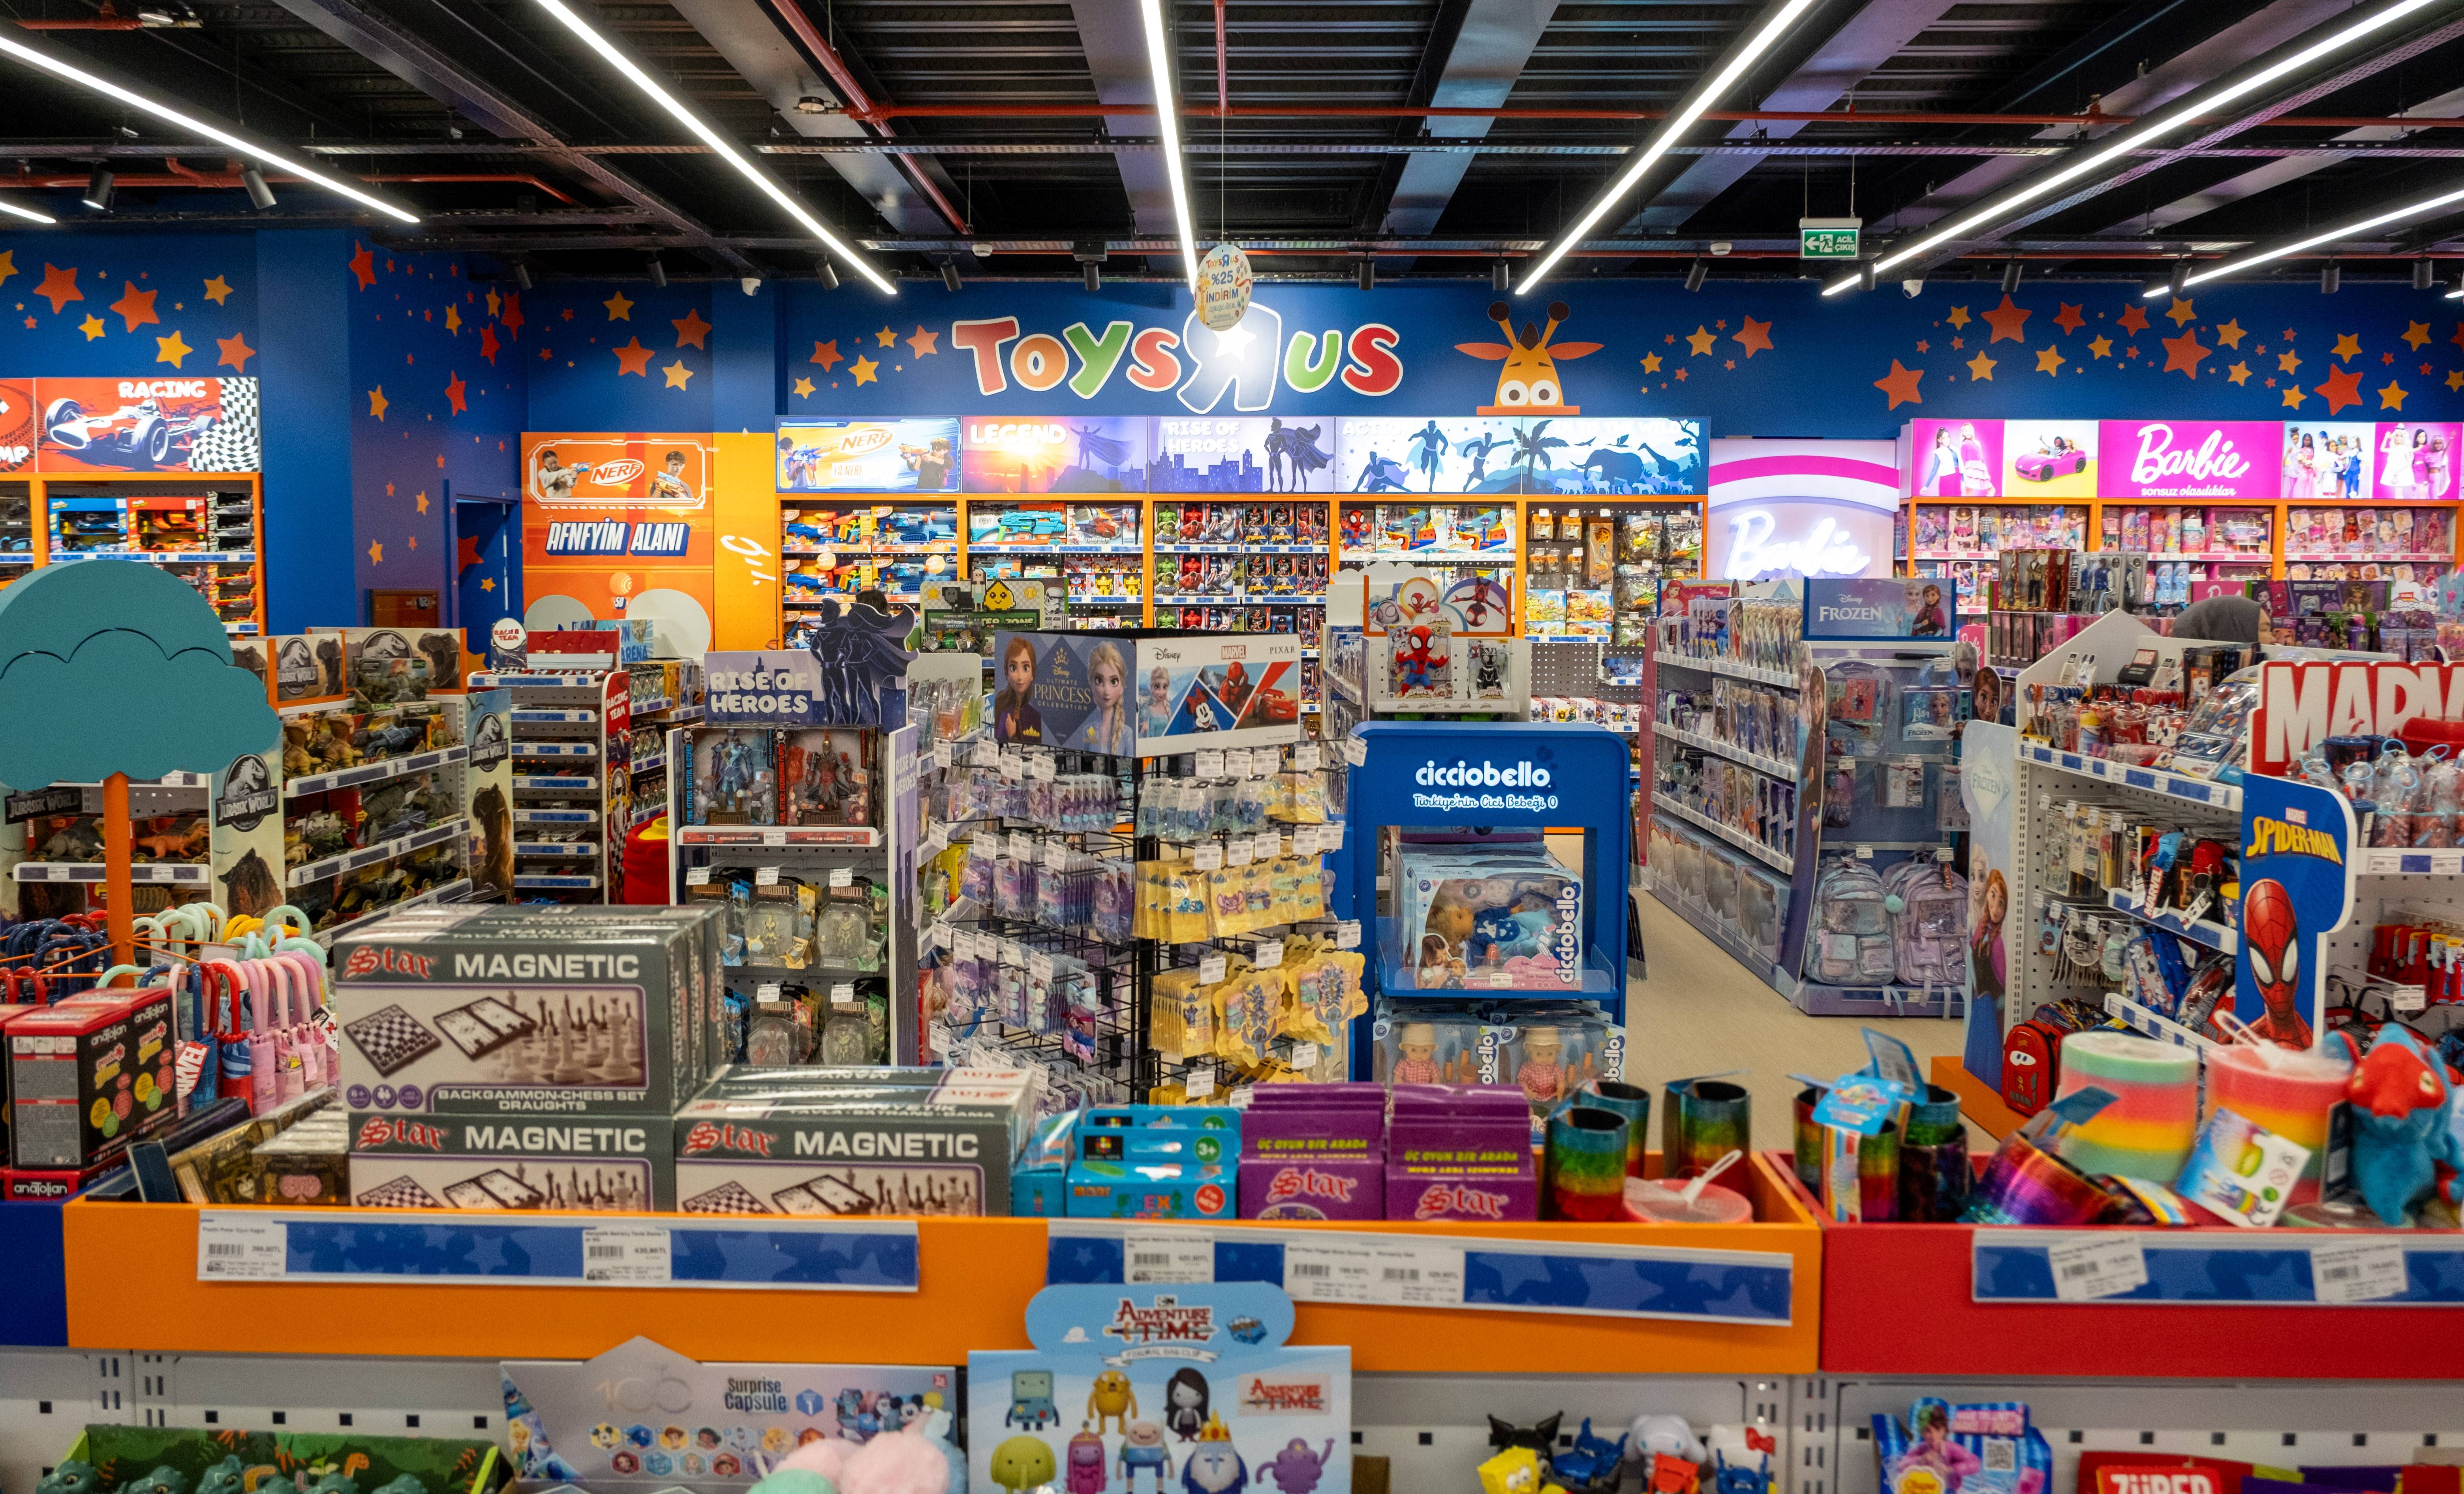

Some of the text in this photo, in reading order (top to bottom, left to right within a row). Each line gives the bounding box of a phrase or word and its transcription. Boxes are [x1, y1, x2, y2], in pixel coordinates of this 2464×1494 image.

[1835, 244, 1855, 252] ÇIKIŞ
[1211, 270, 1233, 285] %25
[1206, 287, 1239, 303] İNDİRİM
[118, 381, 207, 398] RACING
[970, 424, 1067, 445] LEGEND
[1167, 421, 1240, 437] RISE OF
[1554, 421, 1681, 433] IN TO THE WILD
[841, 431, 893, 451] NERF
[1168, 438, 1240, 454] HEROES
[2132, 423, 2250, 484] Barbie
[592, 462, 644, 483] NERF
[2141, 485, 2237, 497] sonsuz olasılıklar
[630, 523, 685, 550] ALANI
[1728, 509, 1871, 580] Barbie
[1838, 594, 1863, 604] Disney
[1819, 606, 1882, 622] FROZEN
[621, 645, 648, 662] ARENA
[1221, 645, 1246, 660] MARVEL
[1270, 646, 1296, 654] PIXAR
[1052, 665, 1070, 678] Disney
[709, 672, 808, 691] RISE OF
[606, 690, 628, 708] RACING
[710, 694, 808, 713] HEROES
[1035, 684, 1091, 704] PRINCESS
[610, 705, 625, 721] TEAM
[1038, 701, 1087, 711] CELEBRATION
[895, 751, 916, 777] RISE OF
[1416, 760, 1551, 788] cicciobello
[1971, 772, 2003, 791] FROZEN
[895, 770, 917, 798] HEROES
[218, 794, 276, 821] JURASSIC WORLD
[1414, 793, 1478, 811] Türkiye'nin
[1480, 794, 1504, 808] Cici
[1506, 794, 1546, 812] Bebeği
[2246, 816, 2342, 866] SPIDER-MAN
[2144, 866, 2164, 917] MARVEL
[1554, 886, 1576, 983] cicciobello
[343, 946, 639, 980] Star MAGNETIC
[438, 1090, 647, 1102] BACKGAMMON-CHESS SET
[499, 1100, 586, 1111] DRAUGHTS
[357, 1117, 646, 1152] Star MAGNETIC
[683, 1122, 979, 1158] Star MAGNETIC
[1198, 1143, 1217, 1156] 3+
[1266, 1167, 1358, 1203] Star
[1415, 1184, 1509, 1219] Star
[1116, 1300, 1210, 1322] ADVENTURE
[1134, 1322, 1209, 1342] TIME
[727, 1377, 782, 1396] Surprise
[1249, 1378, 1322, 1398] ADVENTURE
[724, 1391, 788, 1413] Capsule
[1272, 1393, 1323, 1410] TIME
